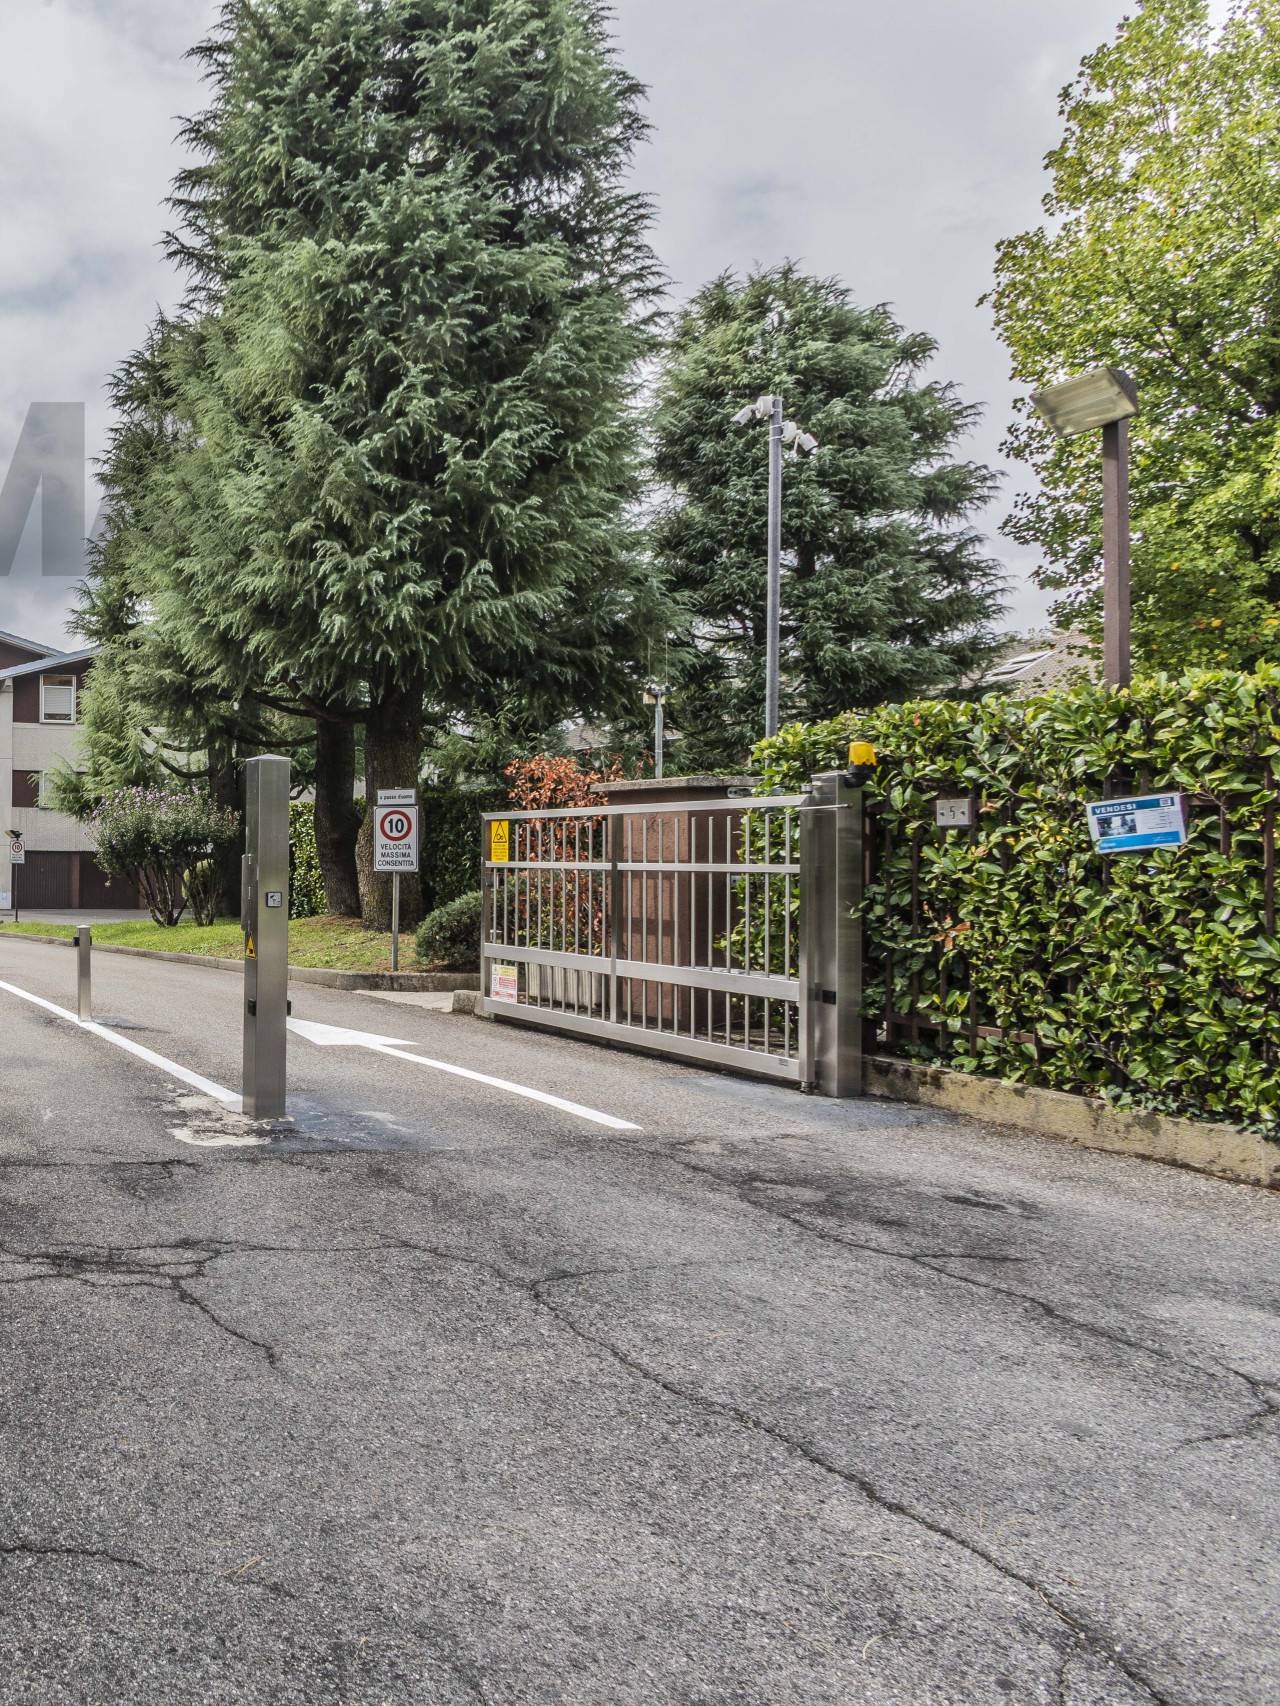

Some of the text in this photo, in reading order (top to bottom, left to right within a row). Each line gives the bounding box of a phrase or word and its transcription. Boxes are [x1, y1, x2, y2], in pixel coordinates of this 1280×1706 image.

[1094, 803, 1137, 814] VENDESI
[388, 818, 405, 833] 10
[377, 859, 414, 867] CONSENTITA
